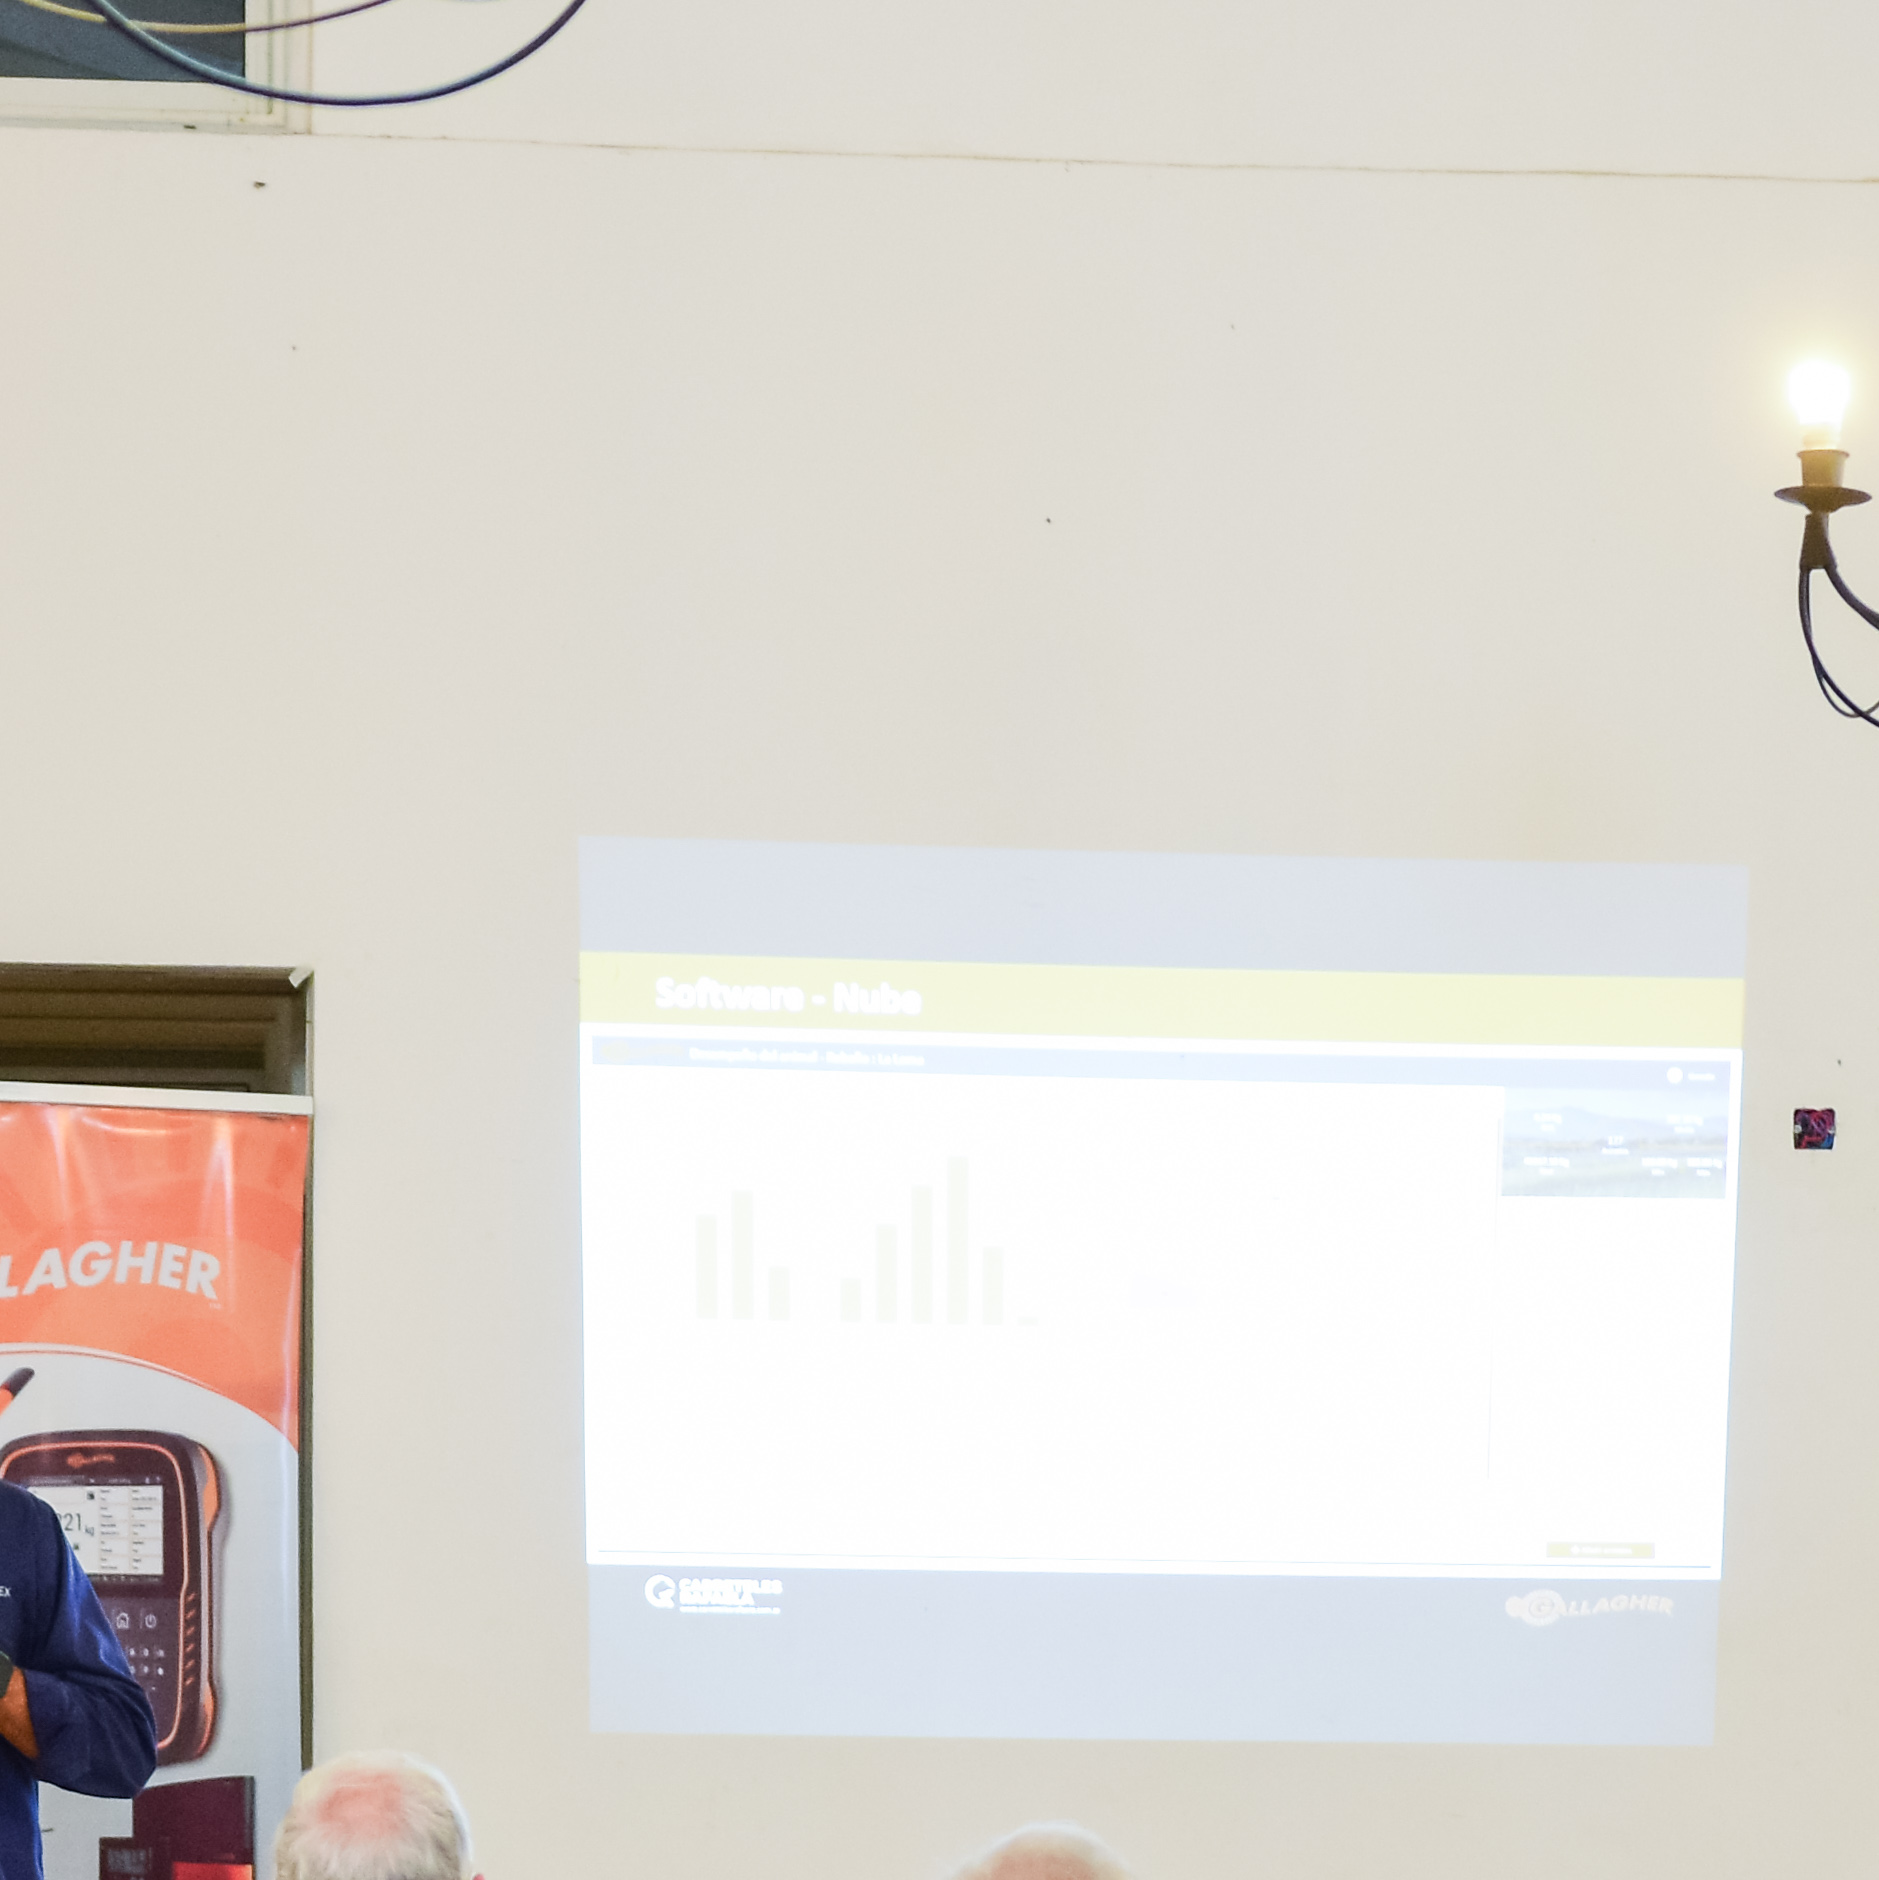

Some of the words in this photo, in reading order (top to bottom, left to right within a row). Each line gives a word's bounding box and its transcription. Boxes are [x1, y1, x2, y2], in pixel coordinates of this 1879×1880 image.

[656, 976, 804, 1013] Software
[833, 981, 922, 1016] Nube
[56, 1513, 81, 1531] 21
